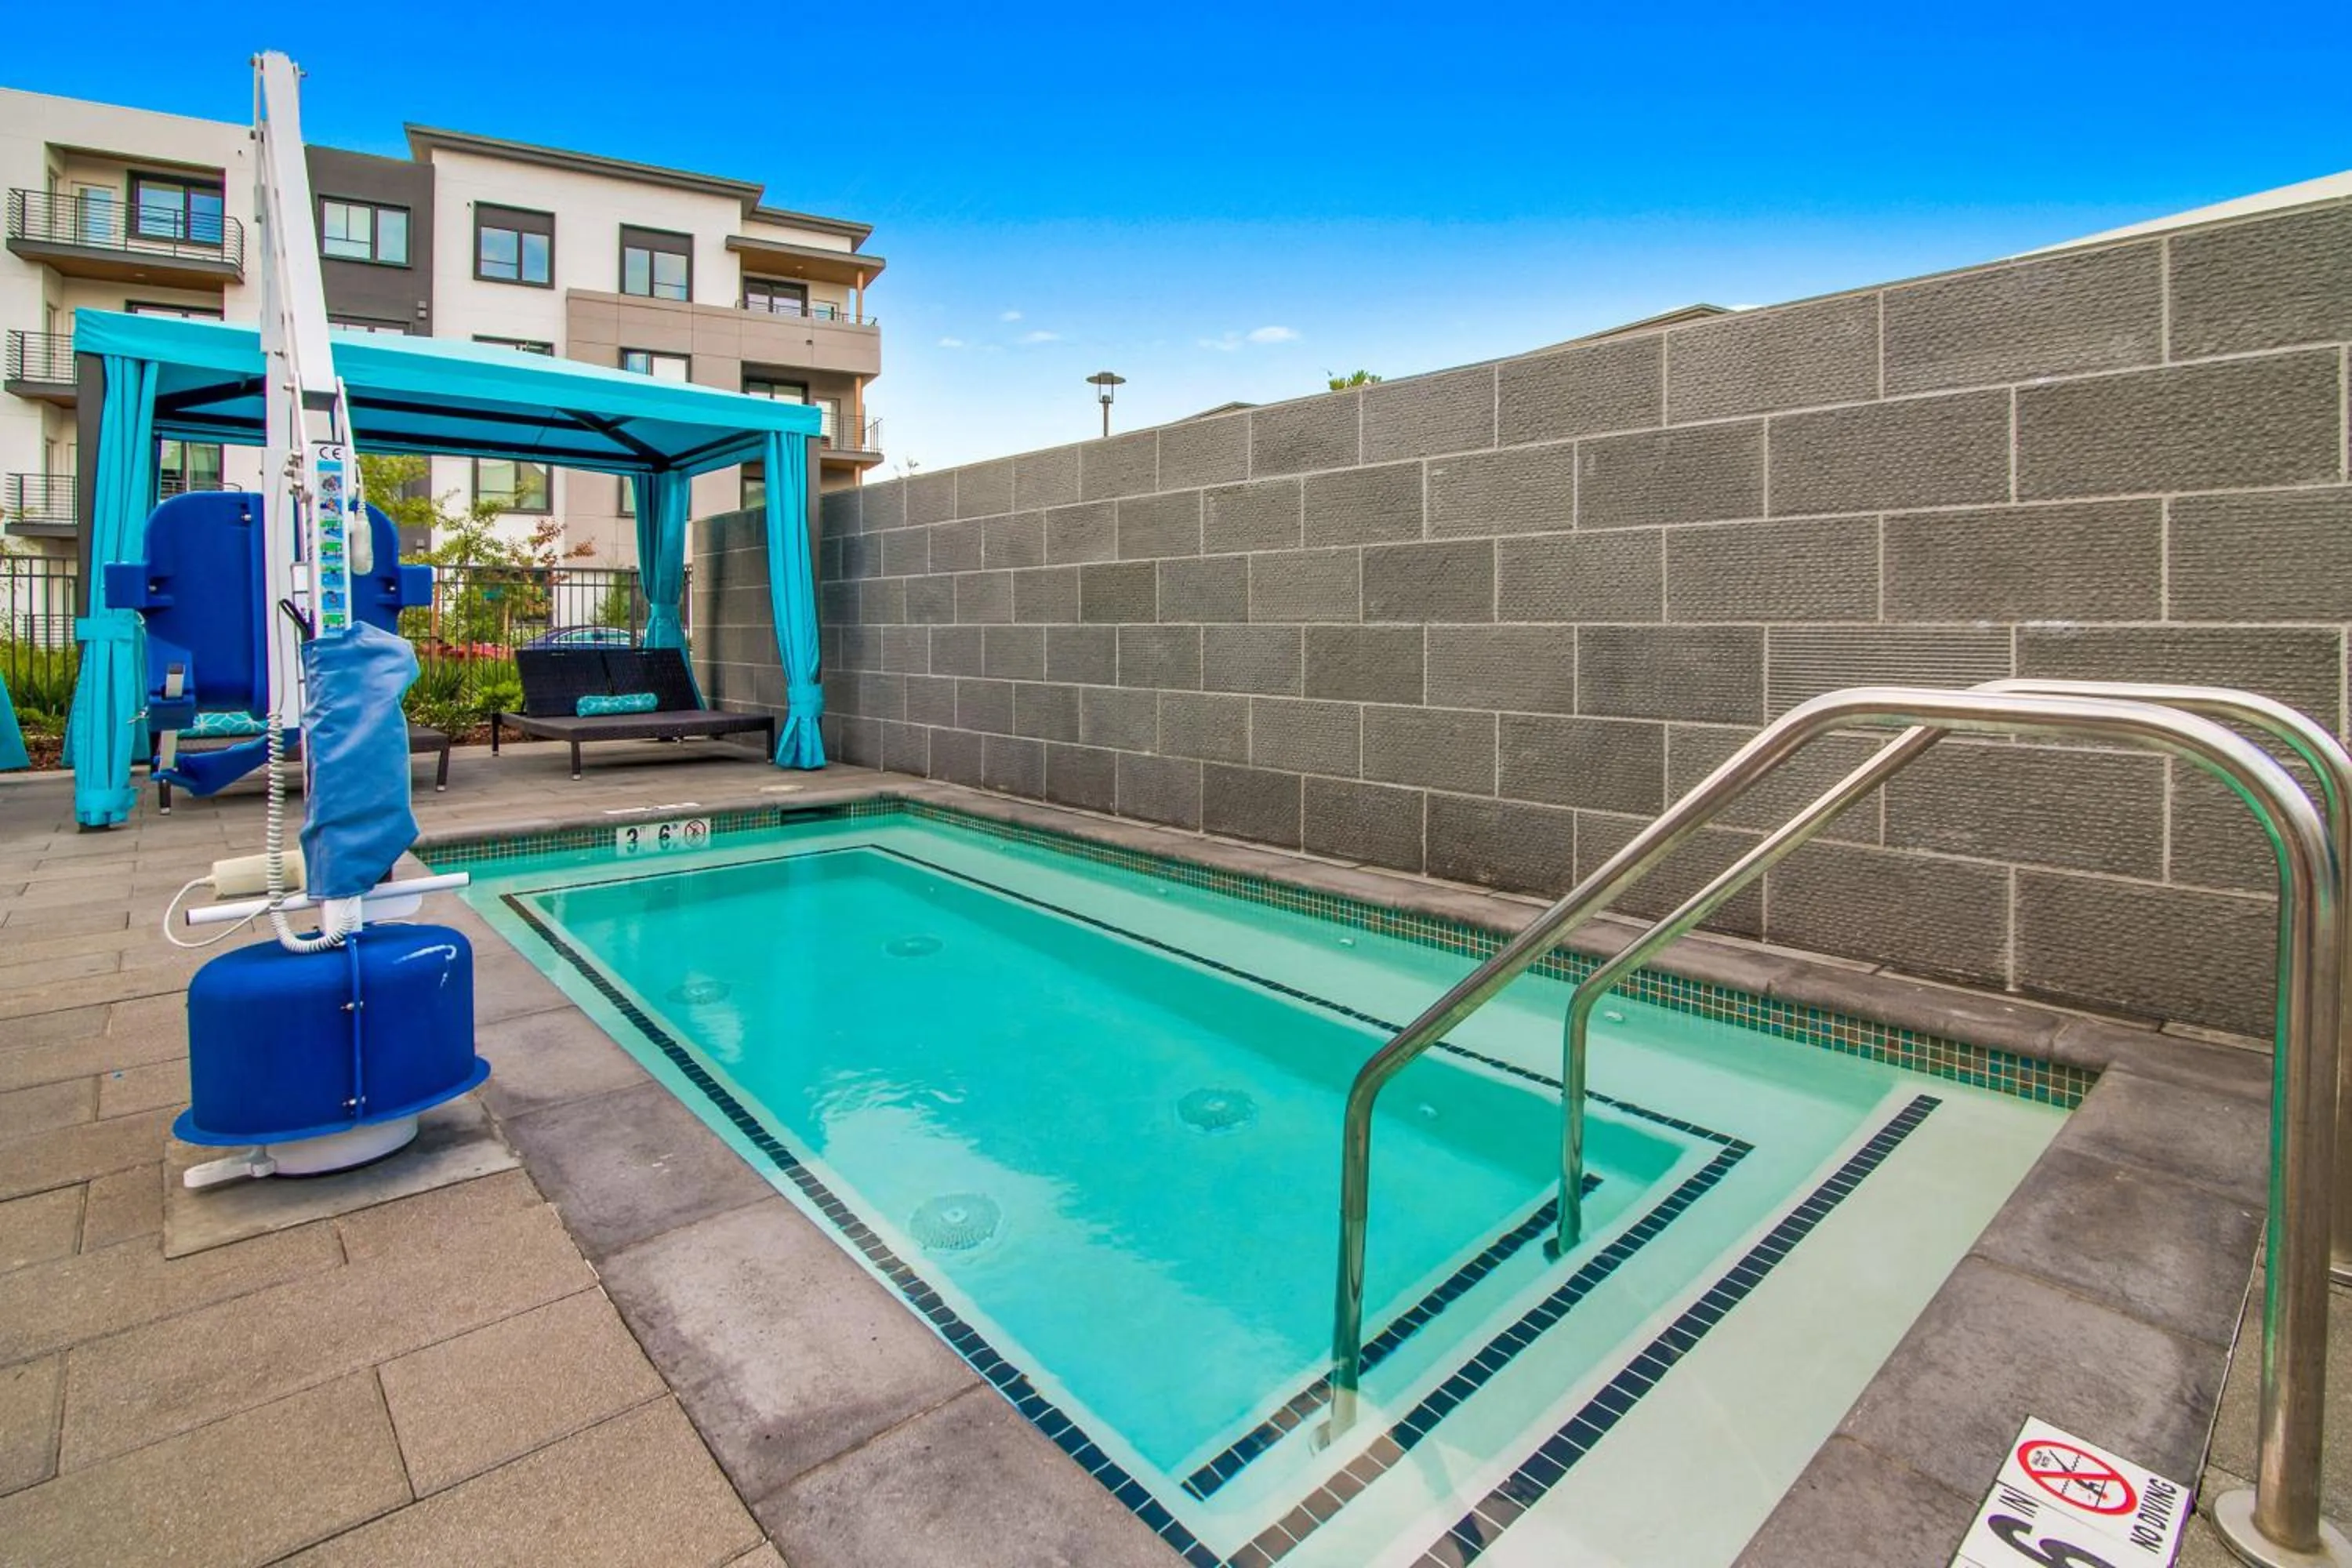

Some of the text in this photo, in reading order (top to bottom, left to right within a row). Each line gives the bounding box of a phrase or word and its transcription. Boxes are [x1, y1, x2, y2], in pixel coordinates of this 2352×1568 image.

[319, 446, 342, 460] CE
[659, 825, 670, 840] 6
[2129, 1478, 2177, 1554] NO DIVING
